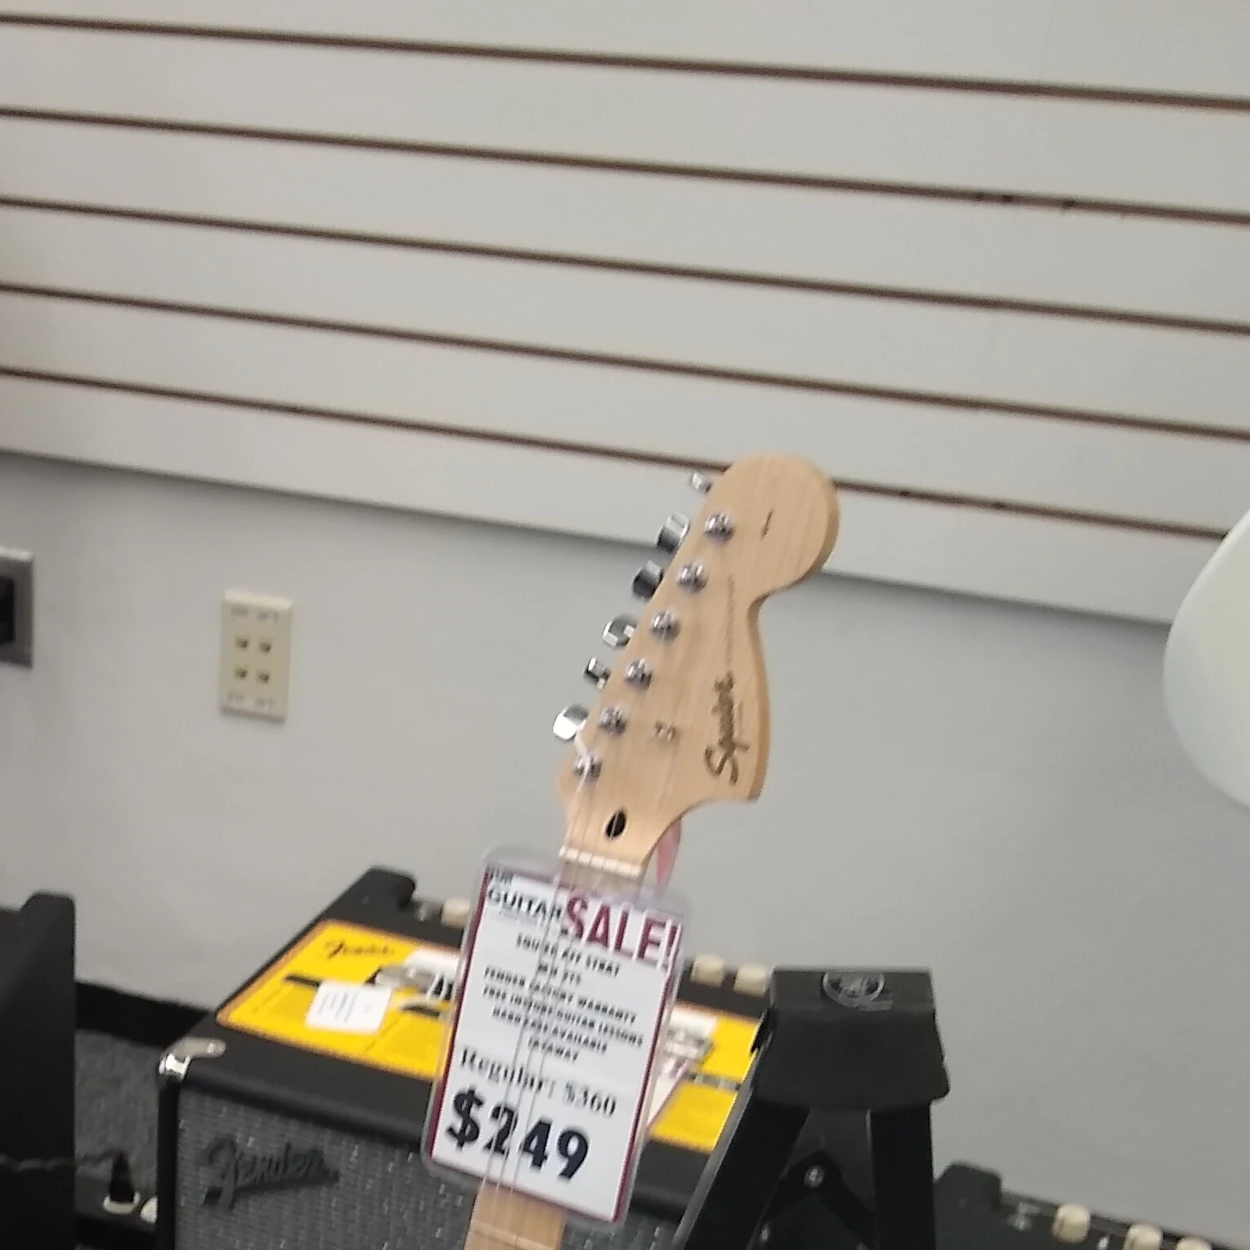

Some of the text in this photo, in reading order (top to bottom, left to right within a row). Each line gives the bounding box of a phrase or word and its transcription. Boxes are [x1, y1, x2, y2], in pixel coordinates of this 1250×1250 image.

[704, 670, 750, 786] Squier
[487, 887, 563, 922] GUITAR
[565, 889, 682, 968] SALE!
[484, 964, 638, 1025] FENDER FACTORY WARRANTY
[585, 954, 620, 977] STRAT
[483, 983, 507, 1001] FREE
[556, 1005, 595, 1029] GUITAR
[598, 1017, 644, 1048] LESSONS
[492, 1004, 608, 1054] HARD CASE AVAILABLE
[528, 1035, 579, 1063] LAYAWAY
[459, 1046, 618, 1118] Regular: $360
[446, 1085, 590, 1183] $249
[201, 1134, 340, 1209] Fender
